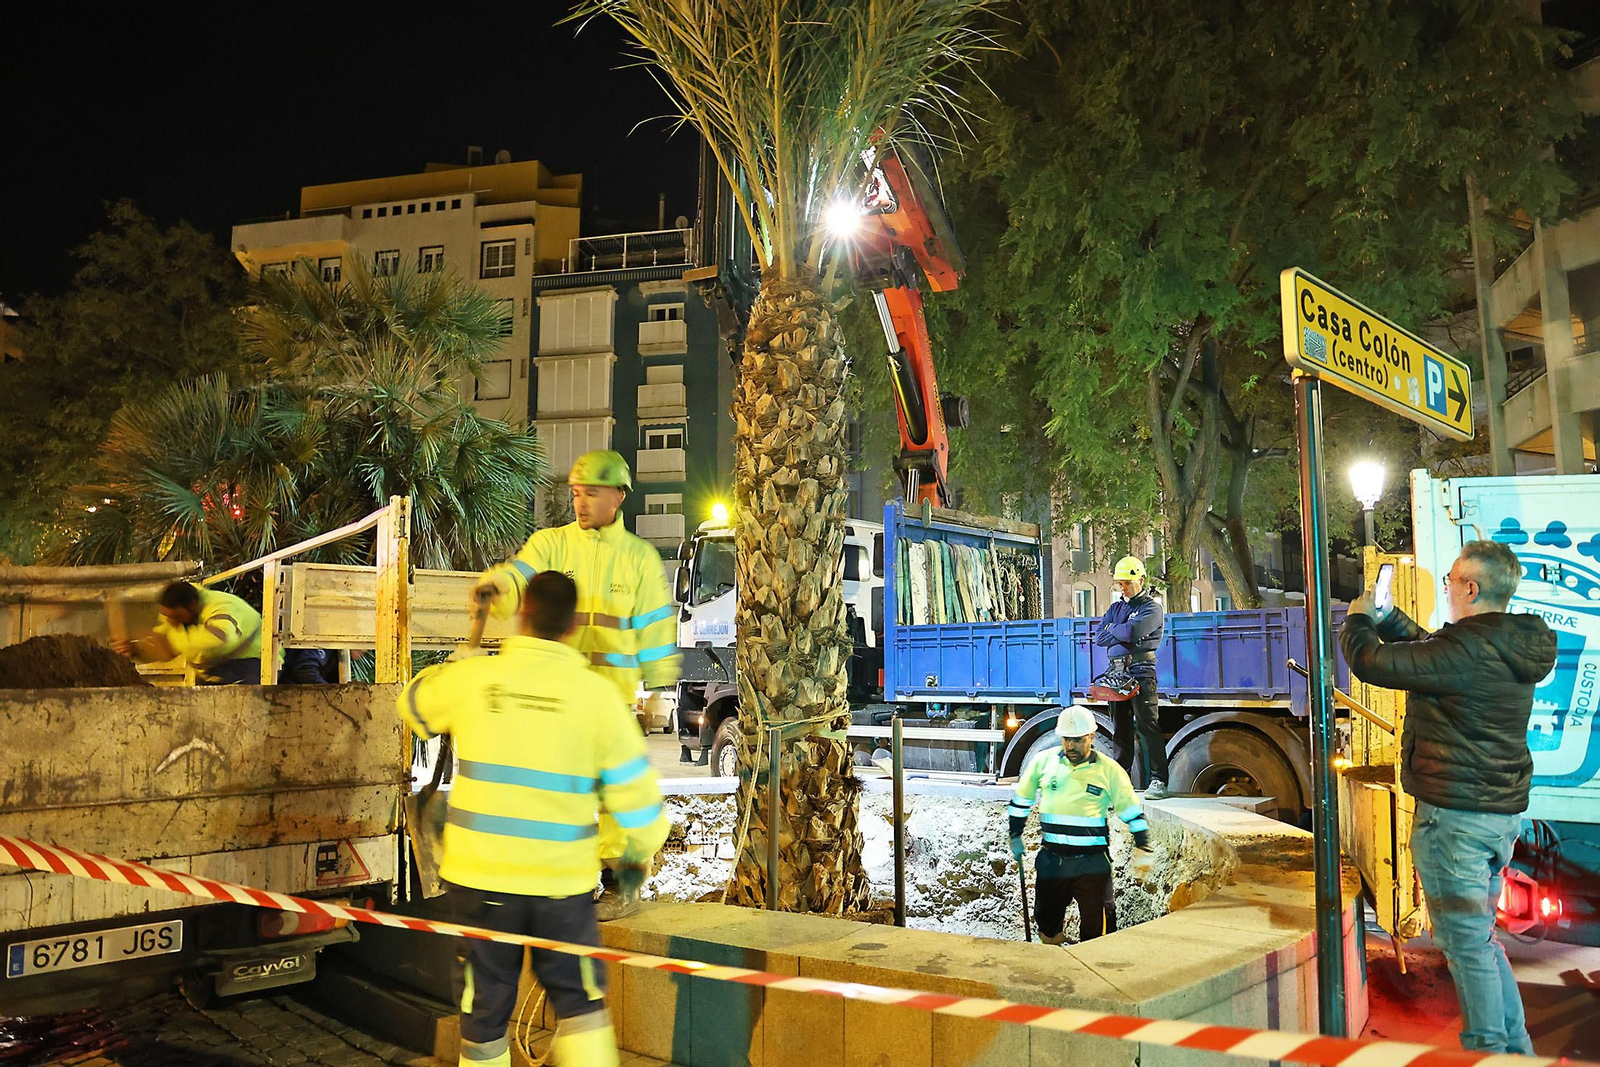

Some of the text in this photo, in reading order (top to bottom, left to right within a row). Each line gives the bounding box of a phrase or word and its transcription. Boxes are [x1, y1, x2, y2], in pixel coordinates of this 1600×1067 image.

[1300, 288, 1411, 374] Casa Colón
[1332, 338, 1389, 390] (centro)
[1426, 360, 1442, 407] P
[1570, 662, 1597, 727] CUSTODIA
[33, 926, 173, 969] 6781 JGS
